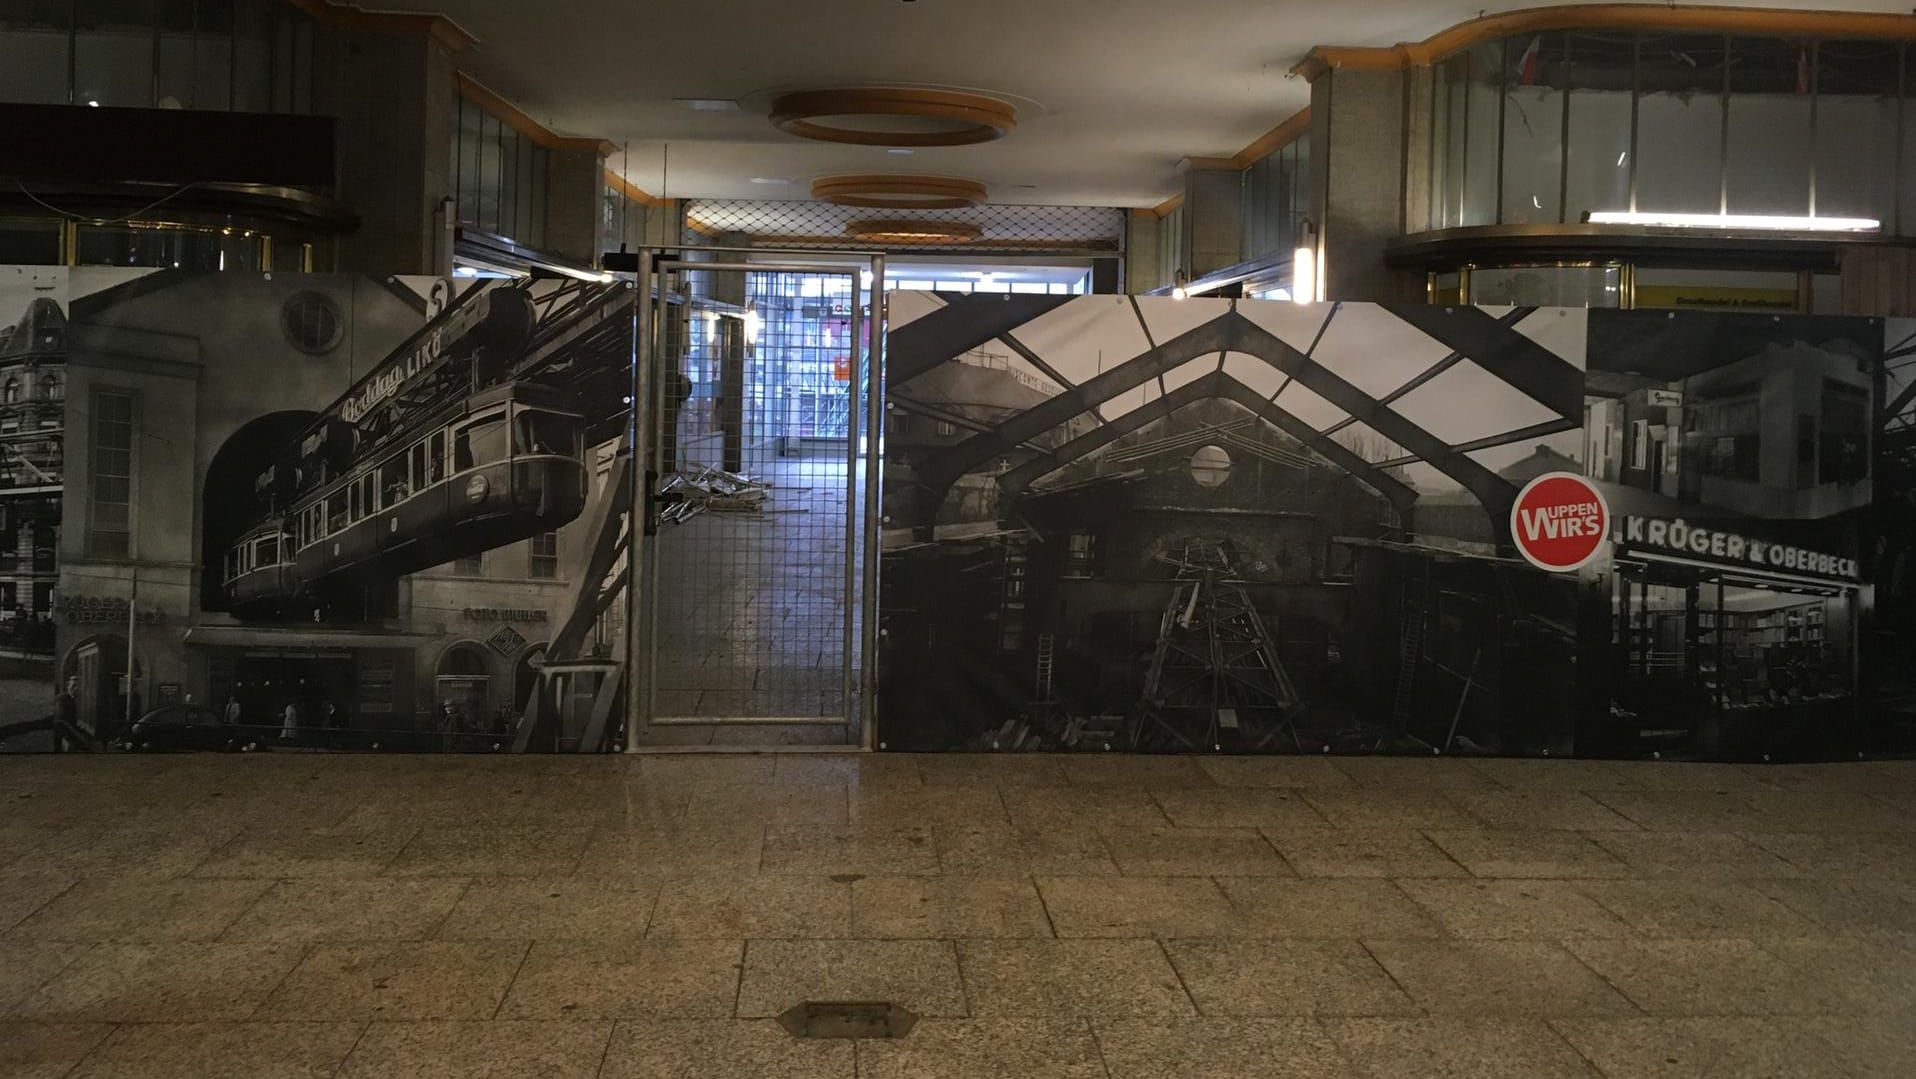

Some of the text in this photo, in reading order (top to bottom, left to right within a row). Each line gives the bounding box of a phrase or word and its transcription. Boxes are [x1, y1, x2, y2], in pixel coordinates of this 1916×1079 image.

[1520, 502, 1598, 541] WUPPEN
[1520, 507, 1600, 541] WIR'S
[1627, 515, 1743, 558] KRÜGER
[1769, 545, 1858, 577] OBERBECK
